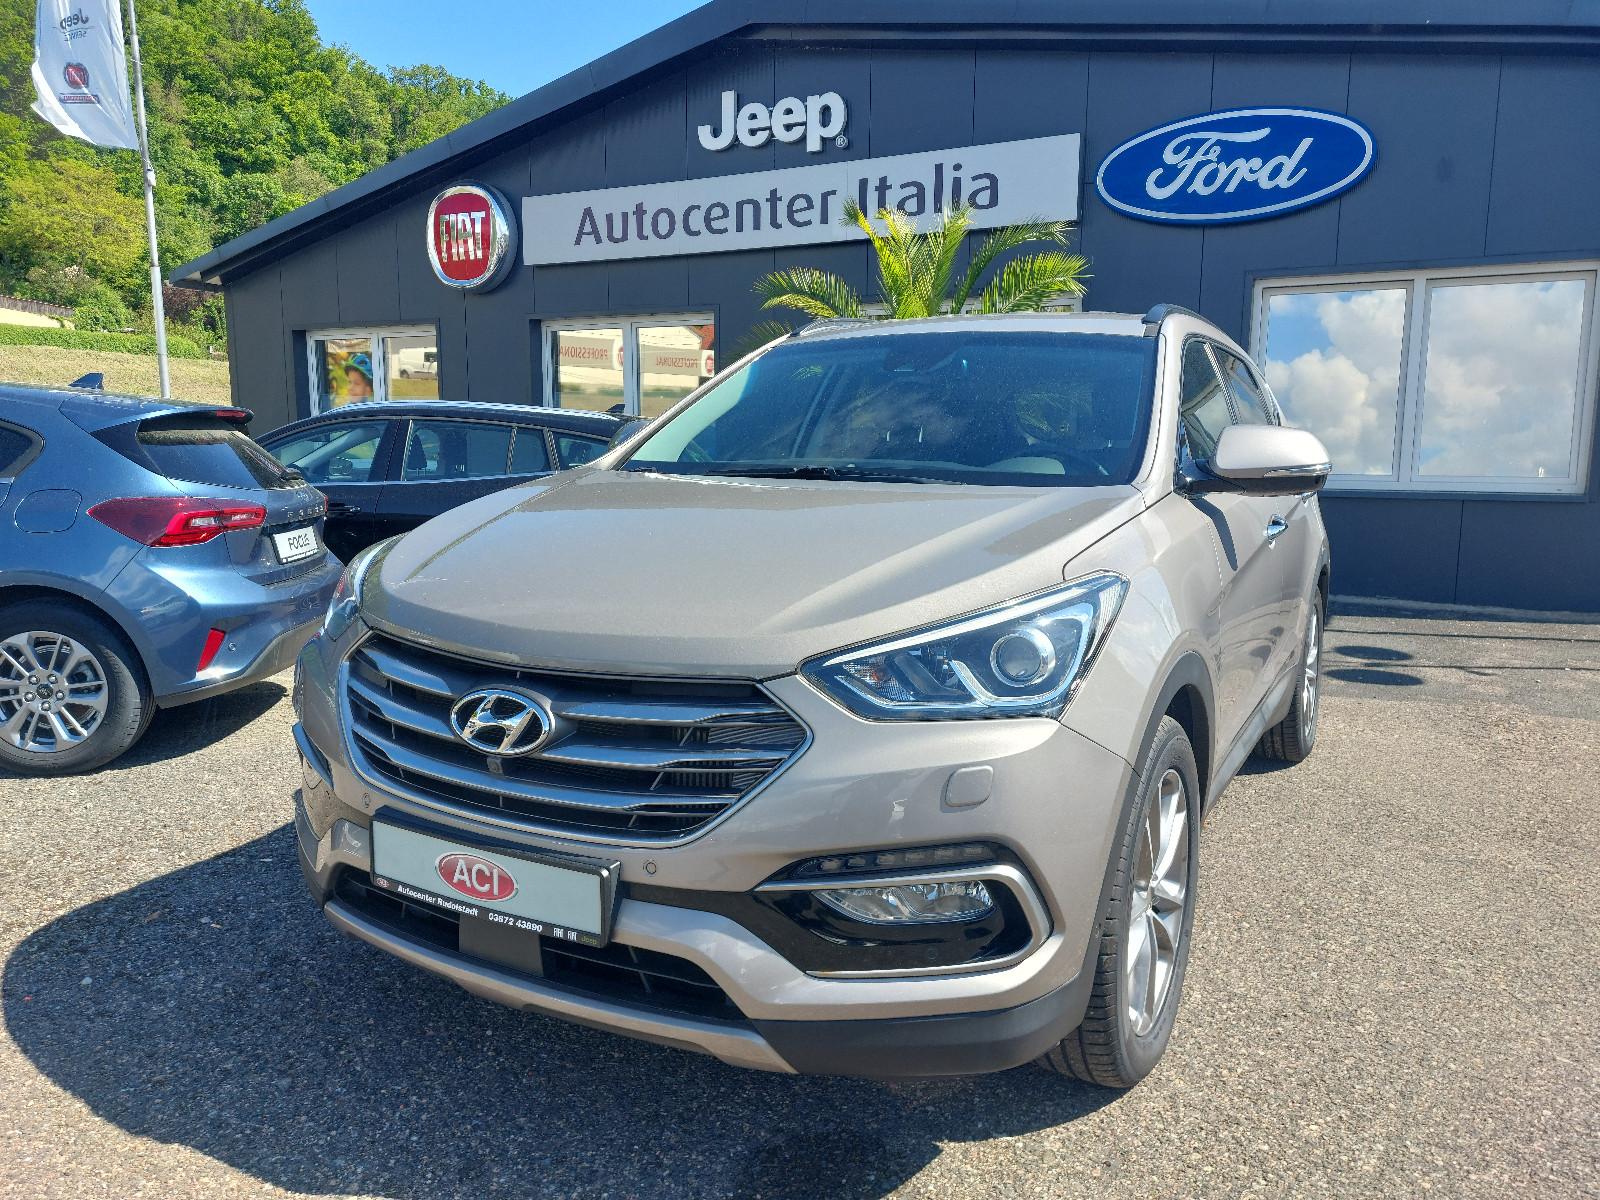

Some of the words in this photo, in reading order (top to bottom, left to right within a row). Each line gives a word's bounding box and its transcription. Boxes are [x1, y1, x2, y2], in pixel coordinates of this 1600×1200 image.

[698, 90, 847, 152] Jeep
[1146, 127, 1313, 200] Ford
[574, 187, 838, 246] Autocenter
[858, 163, 999, 217] Italia
[439, 211, 486, 262] FIAT
[288, 534, 310, 550] FOCUS
[453, 858, 499, 896] ACI
[398, 885, 436, 904] Autocenter
[488, 912, 514, 926] 03672
[515, 920, 543, 933] 43890
